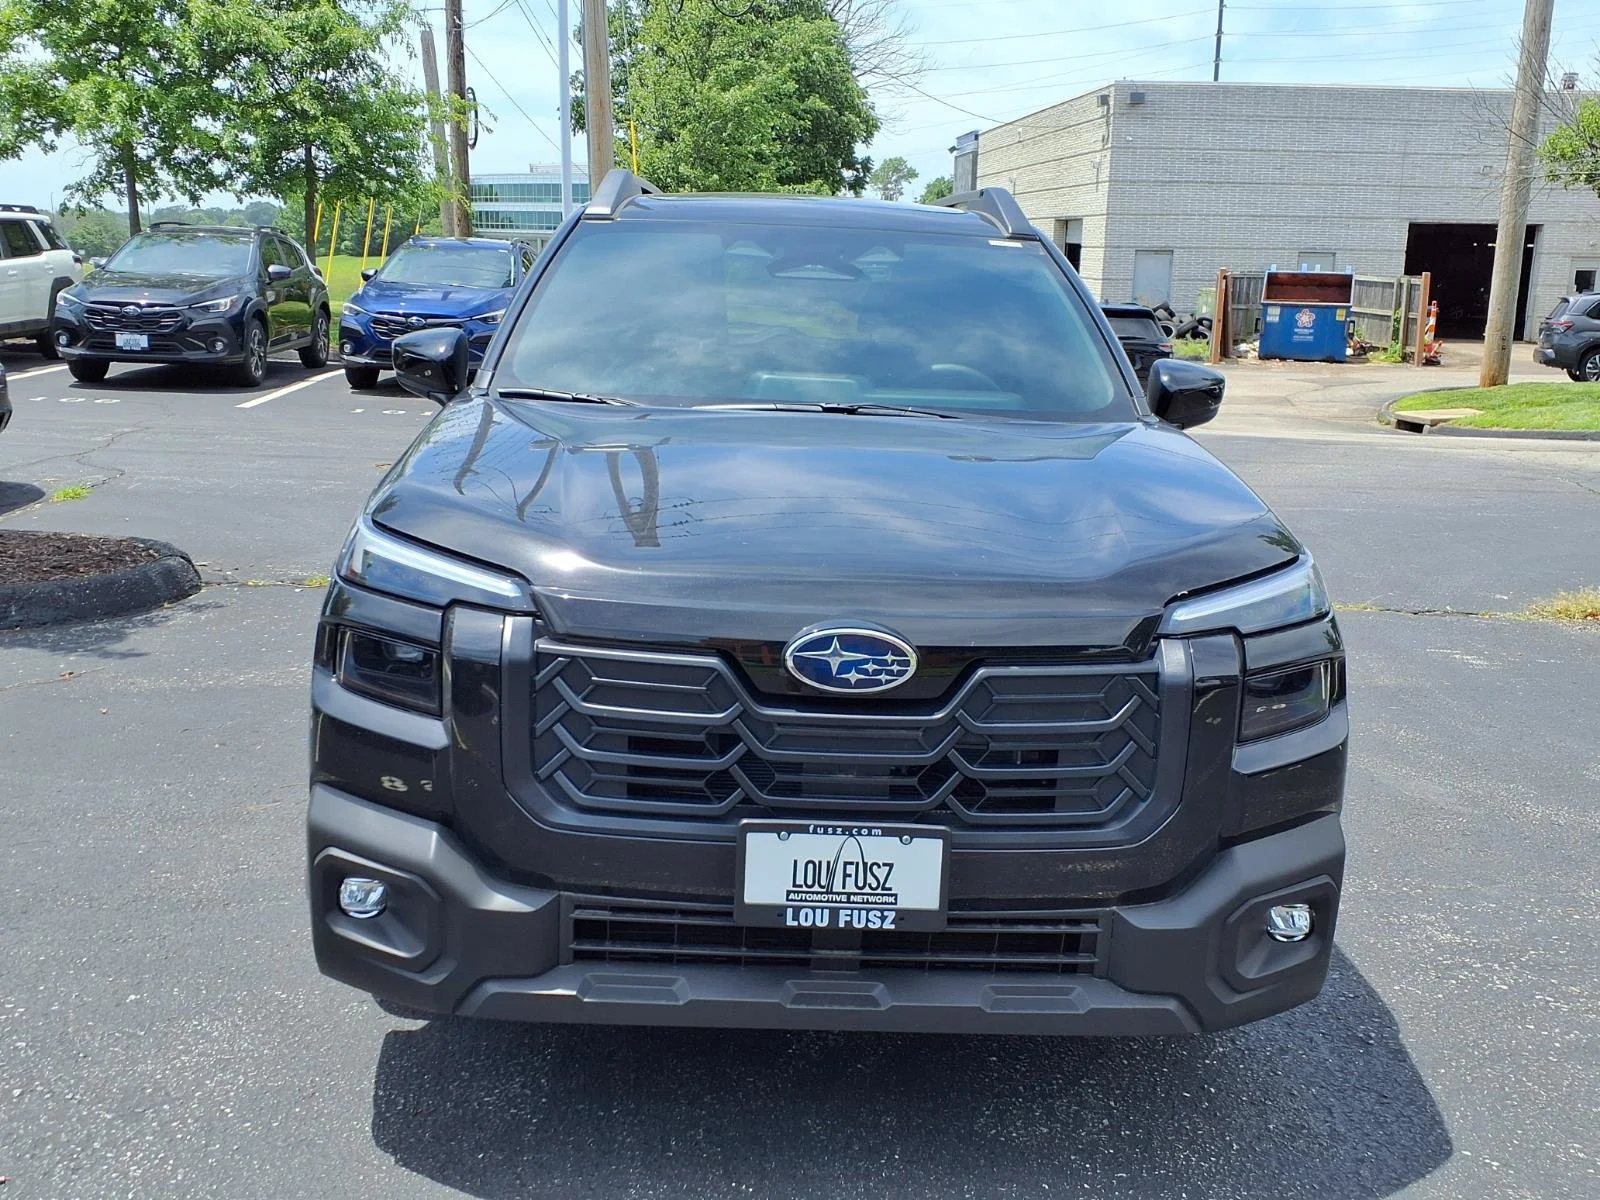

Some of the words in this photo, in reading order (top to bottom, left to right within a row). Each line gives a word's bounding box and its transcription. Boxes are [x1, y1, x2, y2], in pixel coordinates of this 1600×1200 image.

[809, 825, 882, 836] fusz.com
[792, 859, 831, 889] LOU
[842, 861, 895, 891] FUSZ
[788, 893, 847, 902] AUTOMOTIVE
[850, 894, 896, 904] NETWORK
[786, 907, 829, 927] LOU
[838, 909, 896, 929] FUSZ
